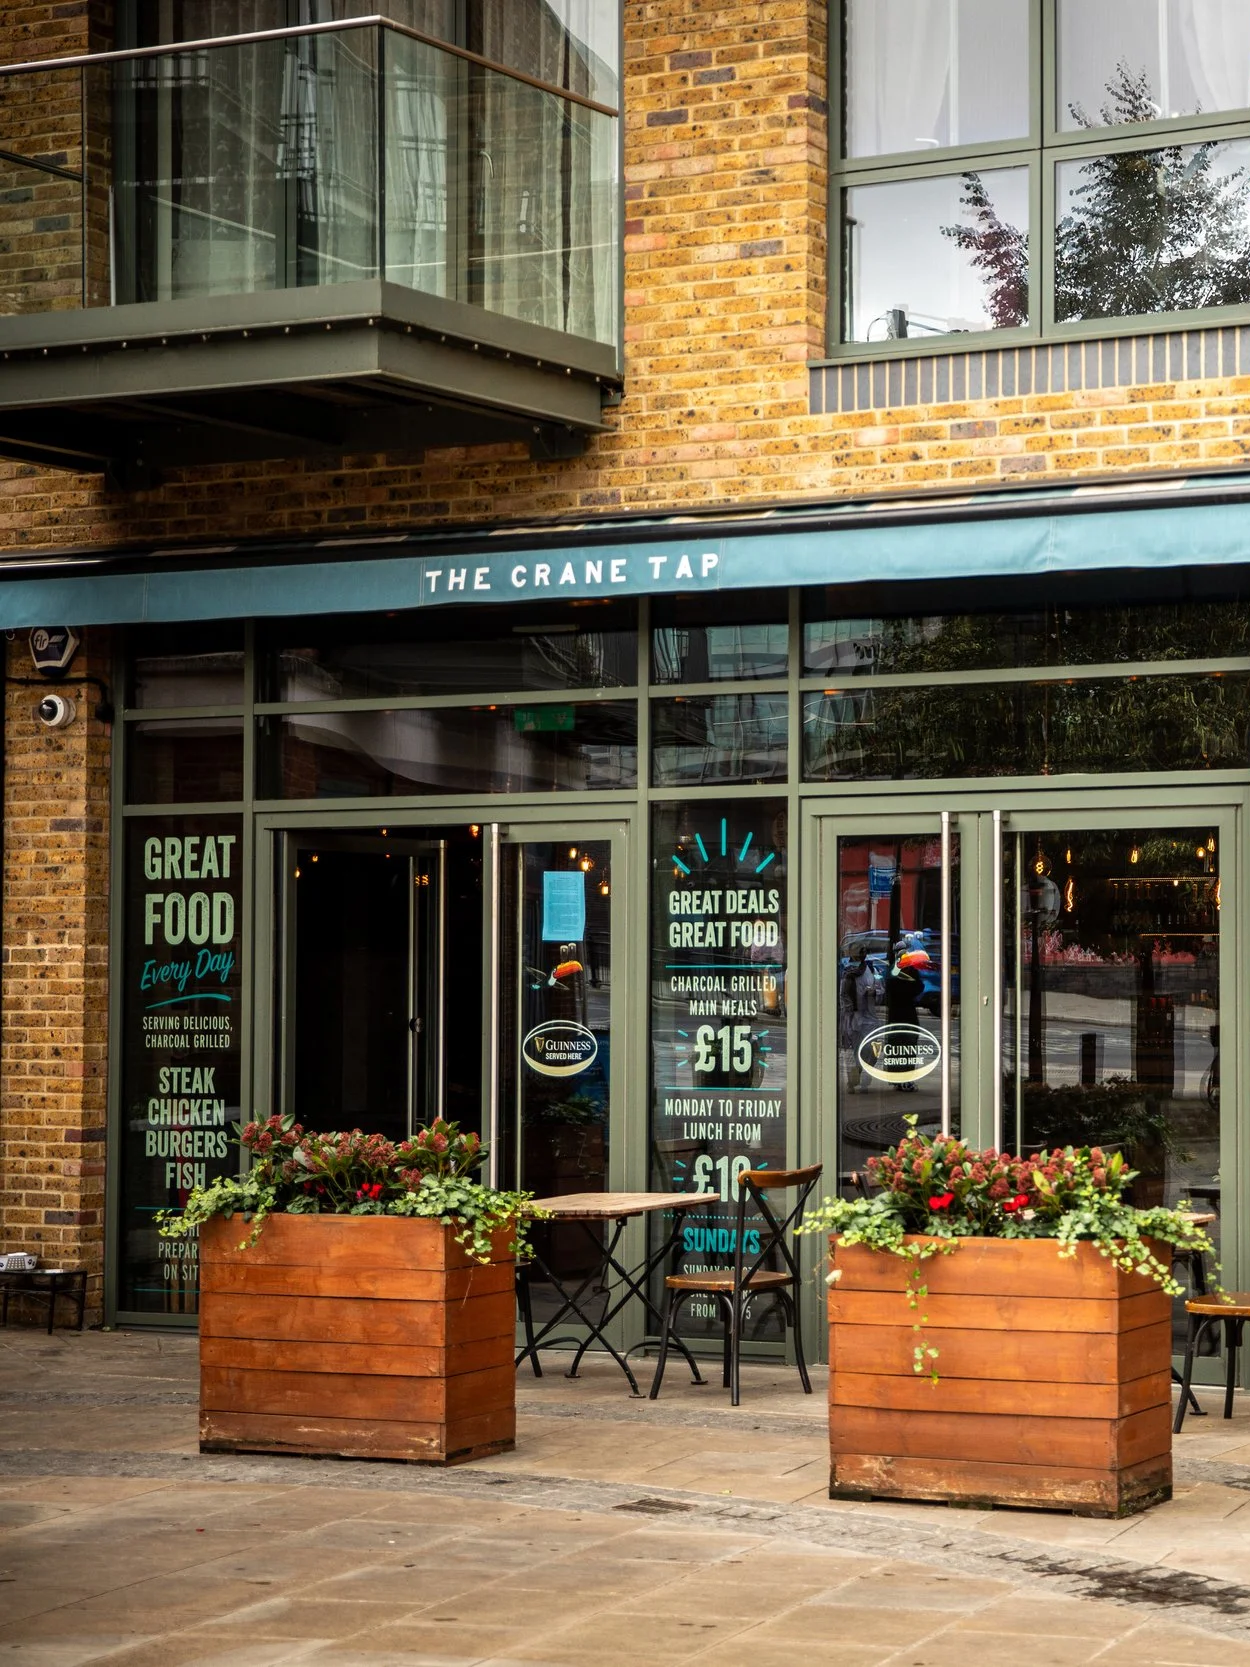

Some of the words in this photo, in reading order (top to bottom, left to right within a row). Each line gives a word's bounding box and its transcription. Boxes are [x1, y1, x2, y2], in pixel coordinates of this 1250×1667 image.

[426, 567, 491, 593] THE
[511, 558, 627, 588] CRANE
[648, 553, 719, 579] TAP
[144, 835, 236, 881] GREAT
[669, 891, 722, 915] GREAT
[726, 889, 779, 914] DEALS
[144, 892, 235, 945] FOOD
[669, 921, 726, 948] GREAT
[731, 921, 779, 948] FOOD
[141, 959, 192, 992] Every
[195, 948, 235, 983] Day
[671, 976, 726, 992] CHARCOAL
[731, 976, 777, 992] GRILLED
[689, 1000, 717, 1016] MAIN
[722, 1000, 757, 1016] MEALS
[143, 1016, 180, 1030] SERVING
[183, 1016, 233, 1032] DELICIOUS,
[145, 1034, 190, 1048] CHARCOAL
[193, 1034, 230, 1048] GRILLED
[545, 1040, 591, 1051] GUINNESS
[694, 1024, 752, 1072] £15
[883, 1044, 934, 1055] GUINNESS
[883, 1057, 907, 1065] SERVED
[908, 1057, 924, 1065] HERE
[159, 1067, 215, 1094] STEAK
[148, 1099, 225, 1126] CHICKEN
[665, 1099, 713, 1117] MONDAY
[719, 1099, 732, 1117] TO
[738, 1100, 781, 1118] FRIDAY
[683, 1122, 722, 1140] LUNCH
[729, 1123, 761, 1141] FROM
[145, 1130, 228, 1159] BURGERS
[165, 1162, 206, 1189] FISH
[158, 1242, 199, 1259] PREPAR
[163, 1264, 178, 1280] ON
[182, 1264, 199, 1280] SIT
[690, 1303, 716, 1318] FROM
